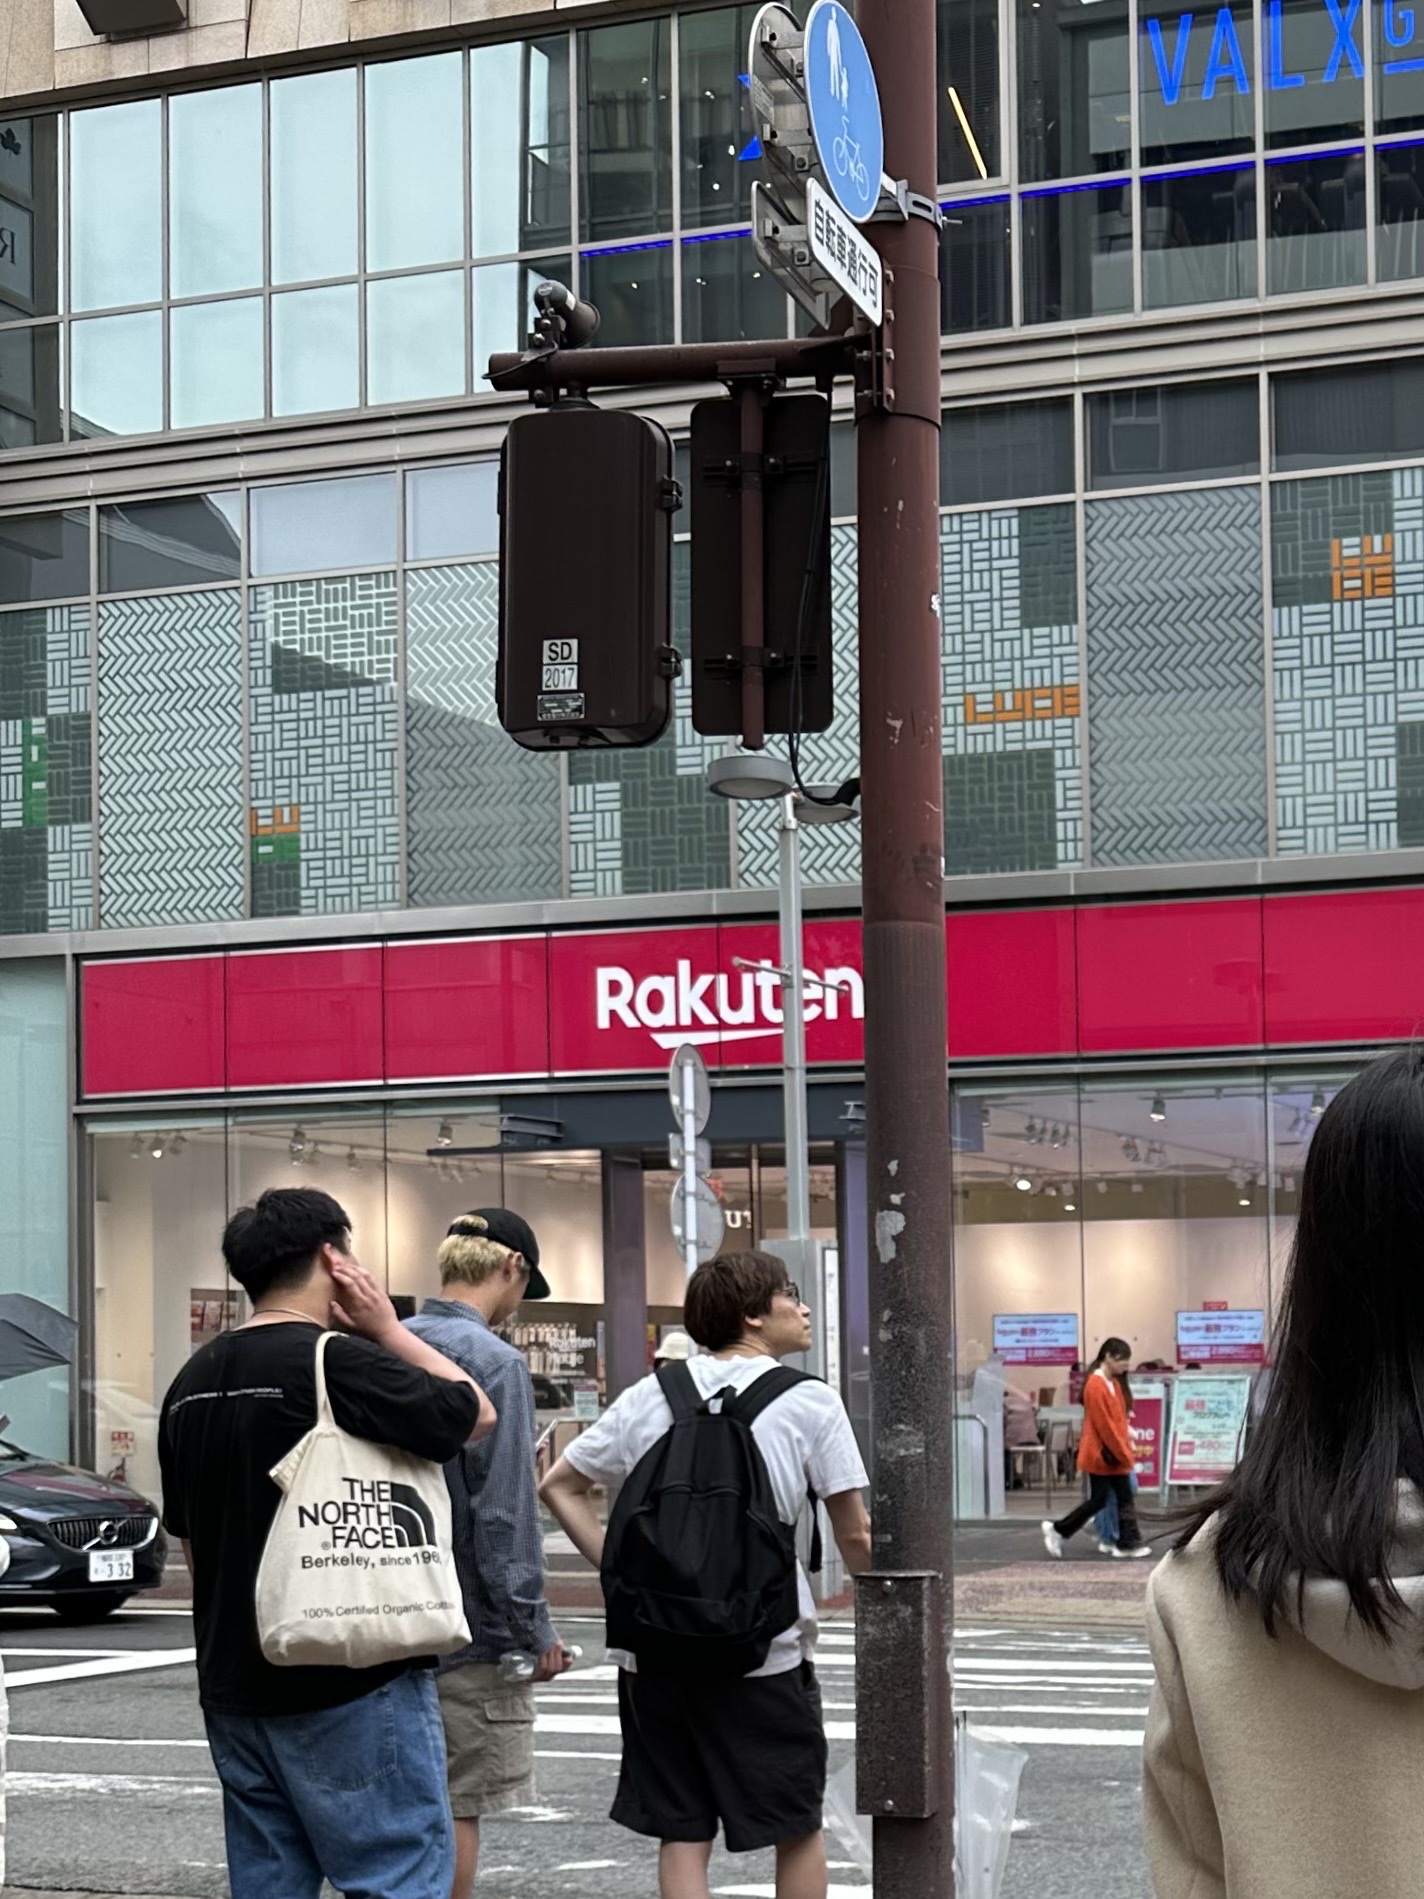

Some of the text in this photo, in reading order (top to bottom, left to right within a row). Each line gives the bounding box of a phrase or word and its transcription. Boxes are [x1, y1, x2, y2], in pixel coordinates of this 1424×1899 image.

[1146, 0, 1365, 106] VALX
[814, 199, 879, 309] 自転車通行可
[548, 641, 572, 662] SD
[544, 667, 575, 689] 2017
[596, 959, 865, 1029] Rakuten
[341, 1477, 391, 1502] THE
[298, 1500, 393, 1528] NORTH
[331, 1526, 396, 1550] FACE
[301, 1552, 376, 1570] Berkeley,
[379, 1556, 412, 1567] since
[302, 1607, 334, 1619] 100%
[335, 1603, 380, 1617] Certified
[382, 1601, 425, 1616] Organic
